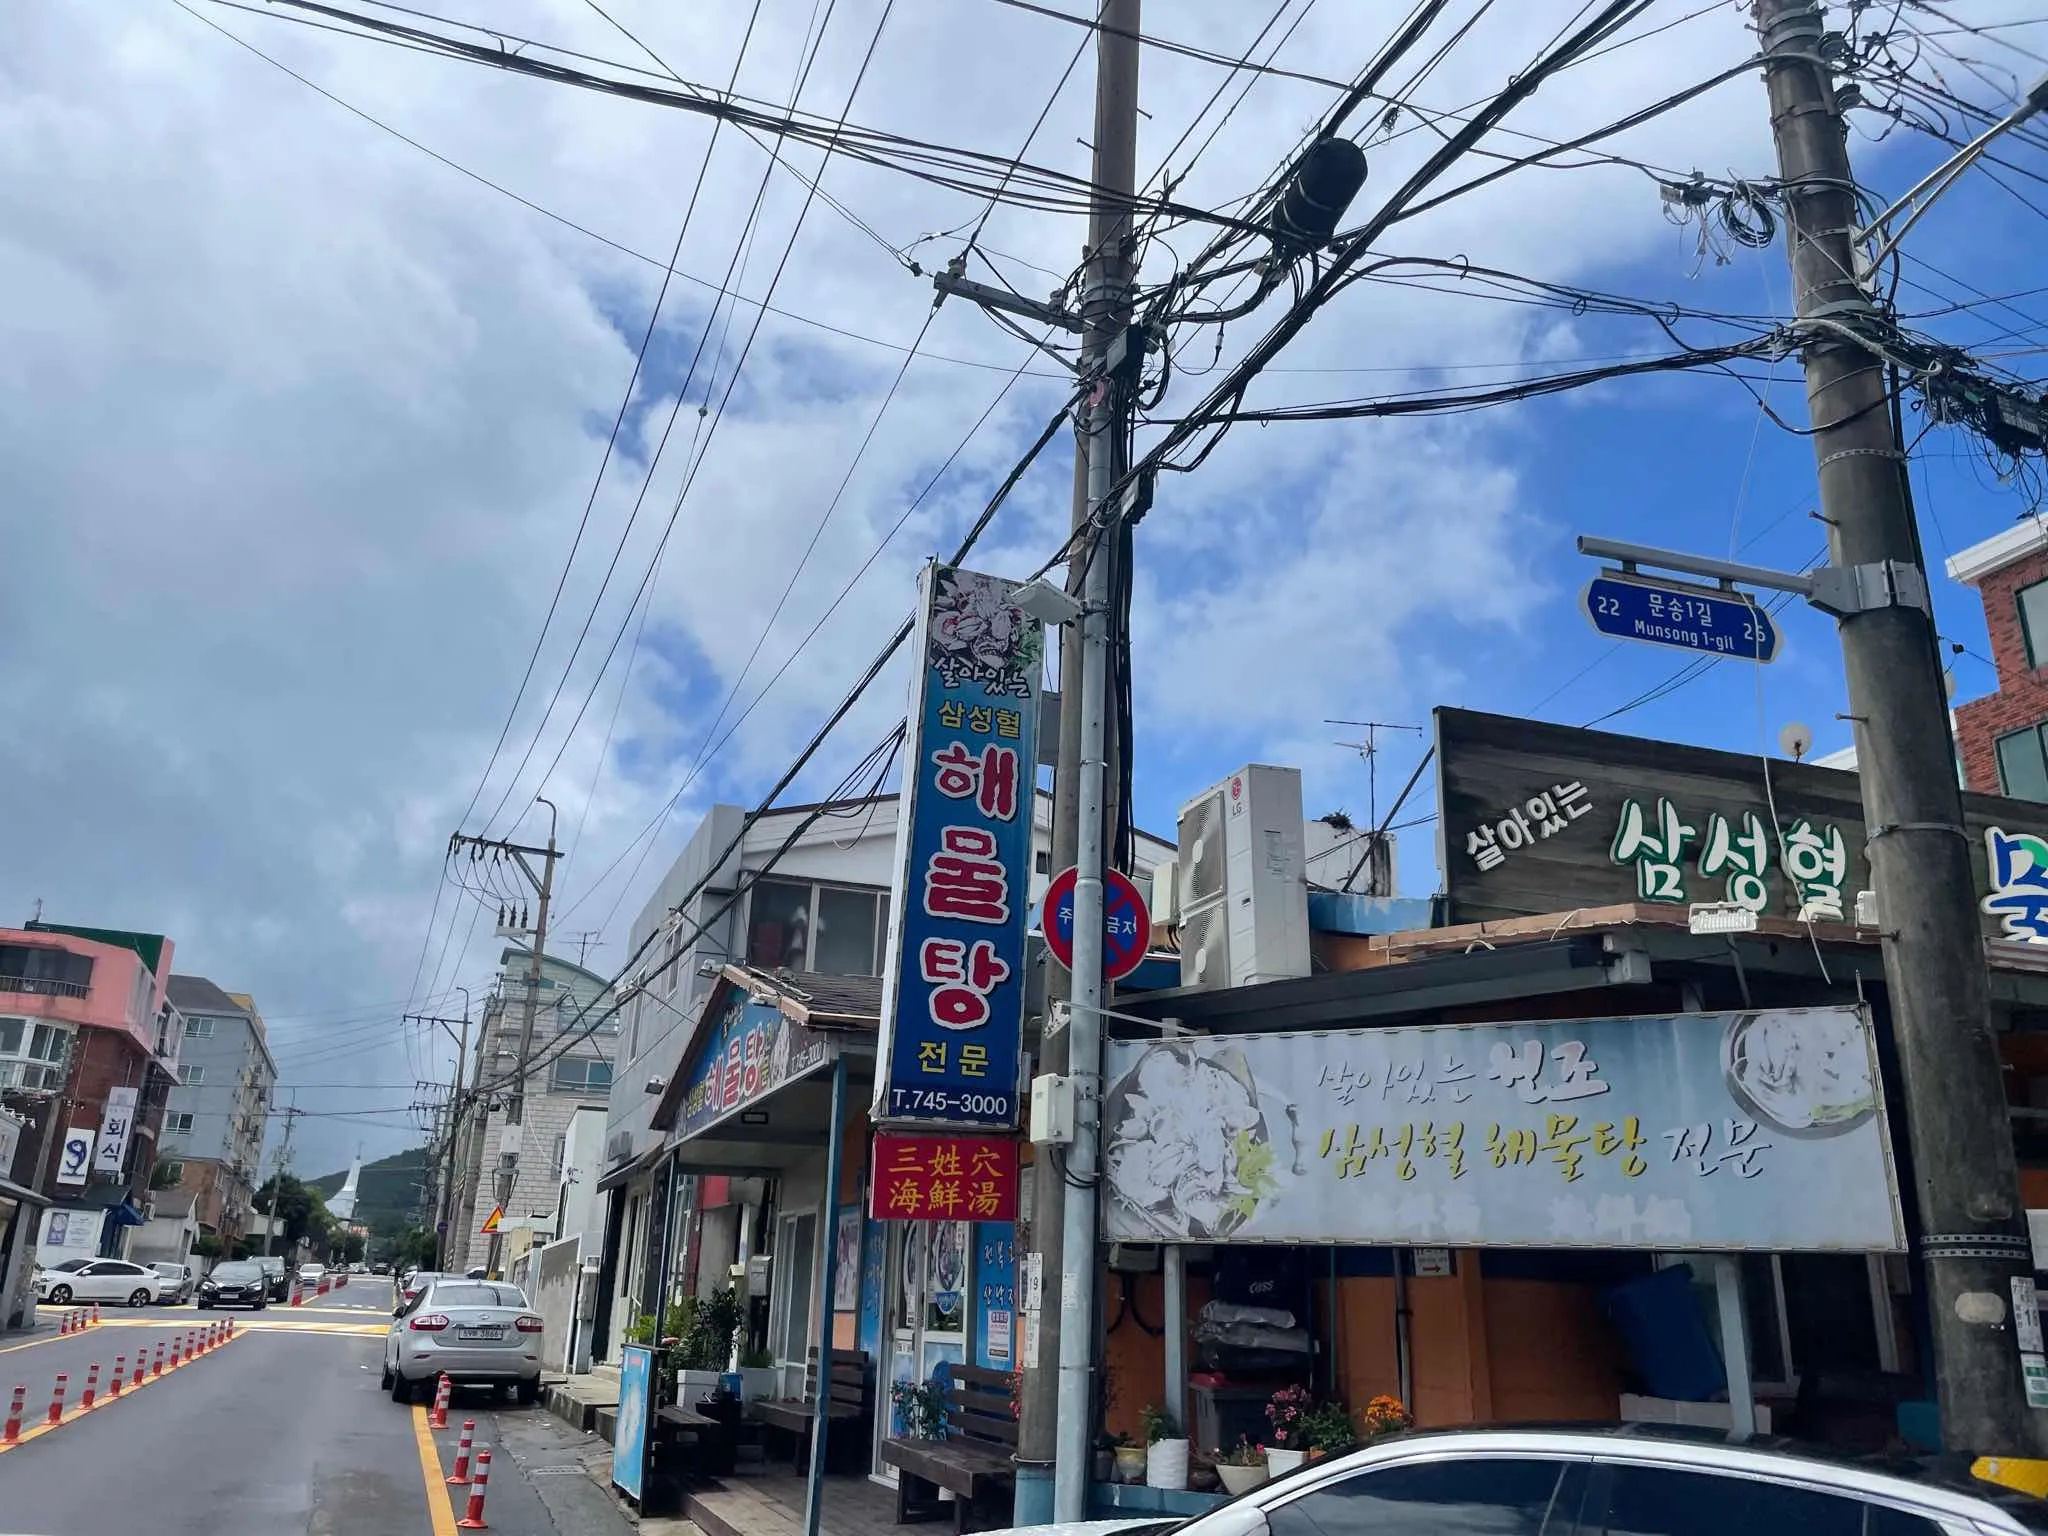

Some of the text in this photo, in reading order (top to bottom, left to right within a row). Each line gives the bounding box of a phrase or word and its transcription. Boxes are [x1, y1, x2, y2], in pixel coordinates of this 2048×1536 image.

[1597, 595, 1621, 617] 22
[1648, 593, 1713, 627] 문송1길
[1634, 619, 1735, 651] Munsong 1-gil
[929, 655, 1031, 698] 살아있는
[937, 699, 1022, 740] 삼성혈
[1232, 802, 1243, 817] LG
[1465, 779, 1594, 872] 살아있는
[1609, 796, 1847, 922] 삼성혈
[919, 740, 1019, 1030] 해물탕
[917, 1041, 990, 1078] 전문
[1317, 1038, 1611, 1106] 살아있는 원조
[892, 1088, 1008, 1116] T.745-3000
[101, 1118, 127, 1163] 회식
[887, 1144, 1005, 1178] 三姓穴
[1319, 1113, 1773, 1183] 삼성혈 해물탕 전문
[887, 1177, 1003, 1218] 海鮮湯
